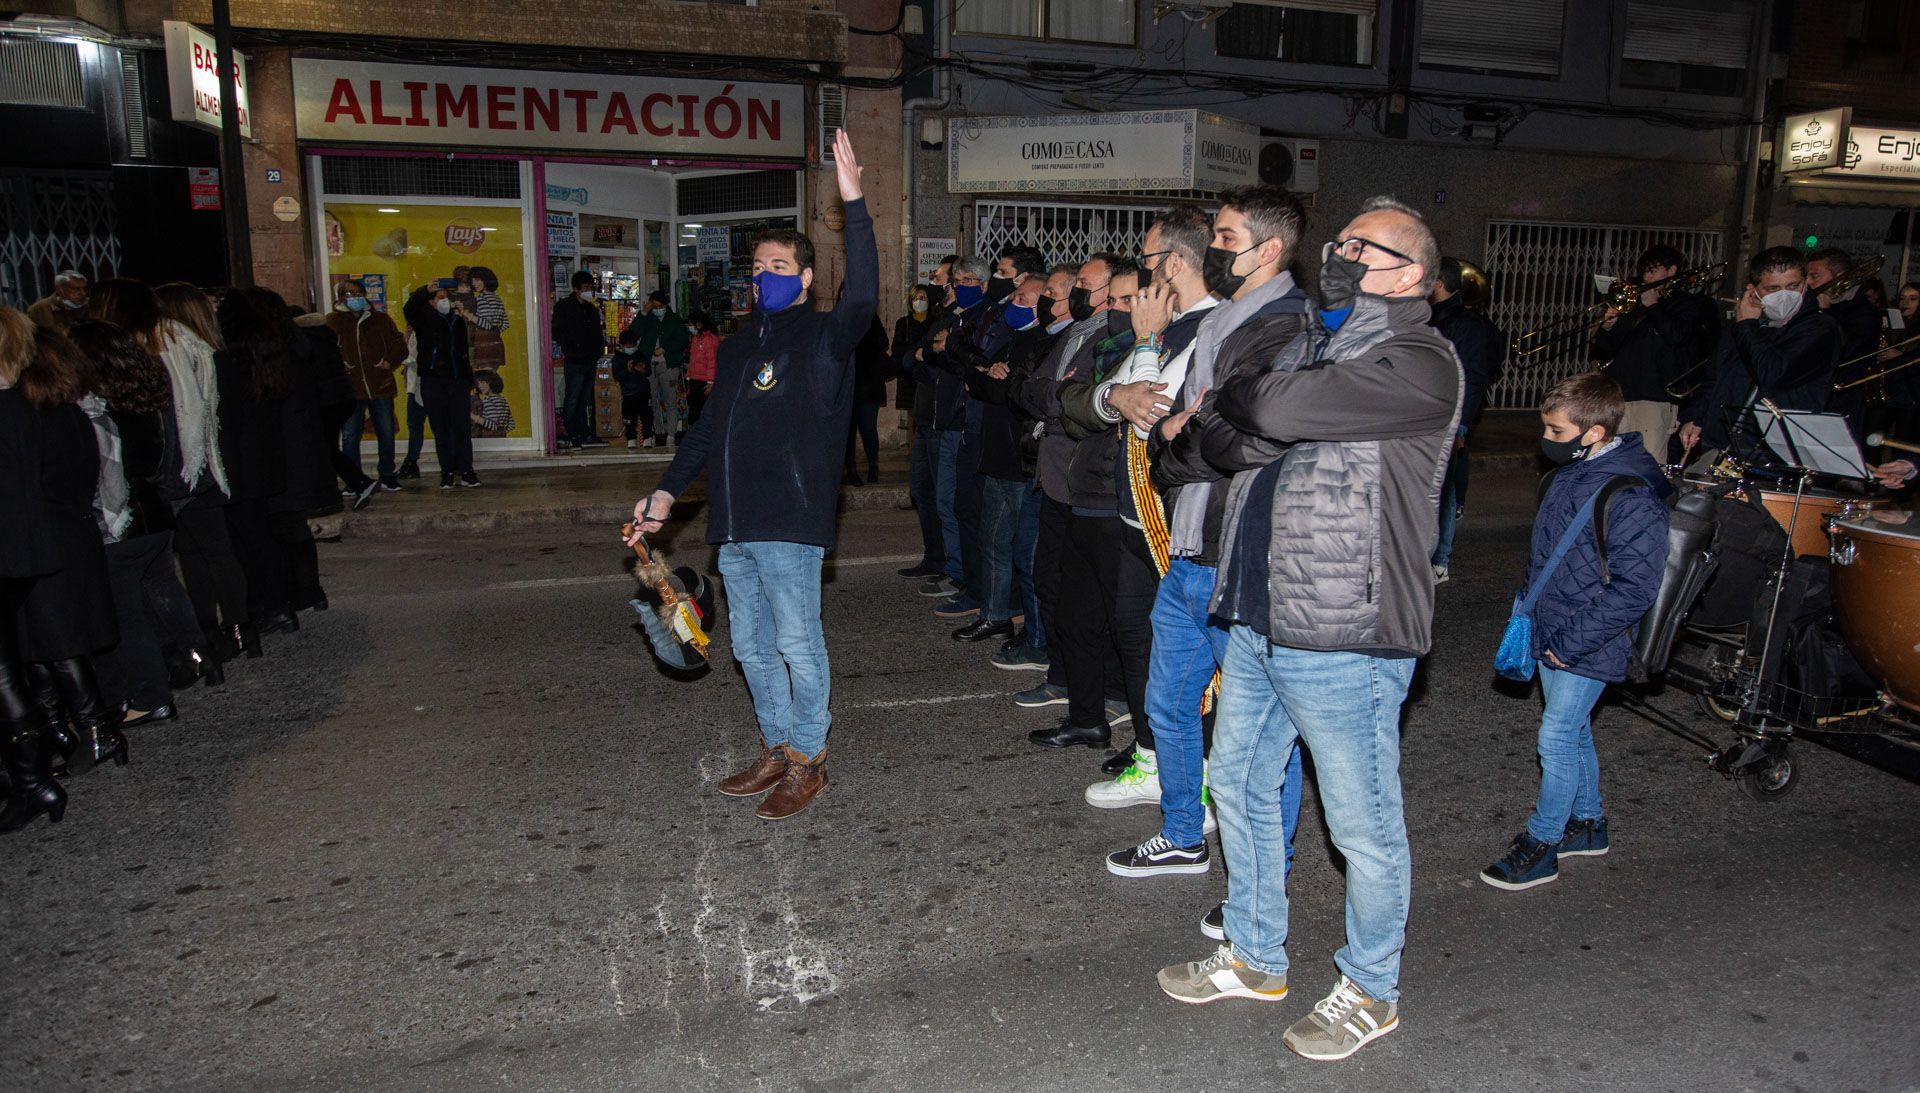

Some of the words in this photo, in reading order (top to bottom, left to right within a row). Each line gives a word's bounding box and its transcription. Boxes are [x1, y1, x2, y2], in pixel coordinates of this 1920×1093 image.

[324, 78, 782, 141] ALIMENTACIÓN
[1022, 142, 1062, 159] COMO
[1077, 140, 1114, 158] CASA
[1791, 139, 1832, 152] Enjoy
[1201, 140, 1225, 161] COMO
[1232, 146, 1252, 166] CASA
[267, 171, 280, 181] 29
[1436, 192, 1445, 202] 31
[566, 217, 577, 226] DE
